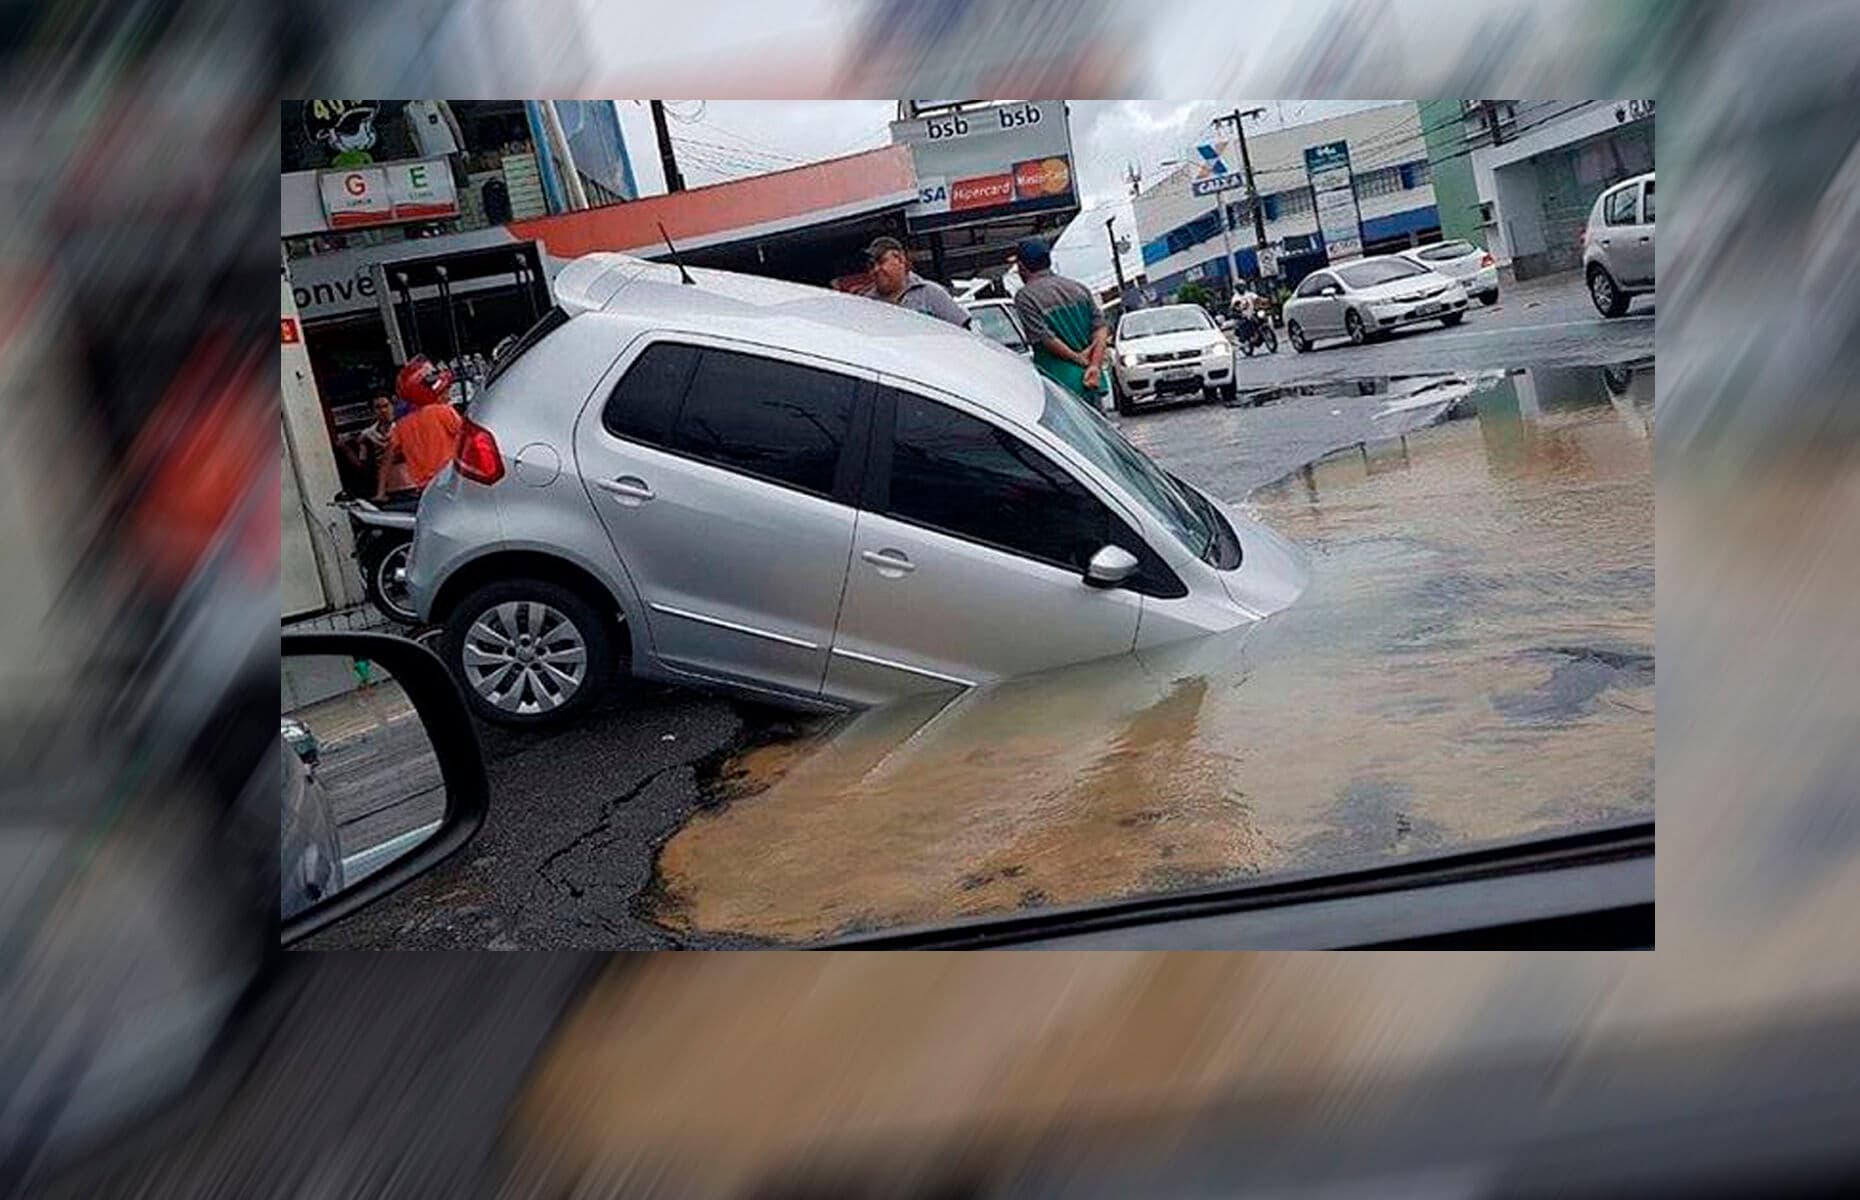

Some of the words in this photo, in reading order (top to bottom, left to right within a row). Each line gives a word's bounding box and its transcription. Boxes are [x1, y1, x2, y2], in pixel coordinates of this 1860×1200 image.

[927, 116, 969, 139] bsb
[999, 103, 1041, 129] bsb
[344, 174, 366, 196] G
[409, 165, 428, 188] E
[1198, 174, 1240, 194] CAIXA
[919, 186, 947, 203] SA
